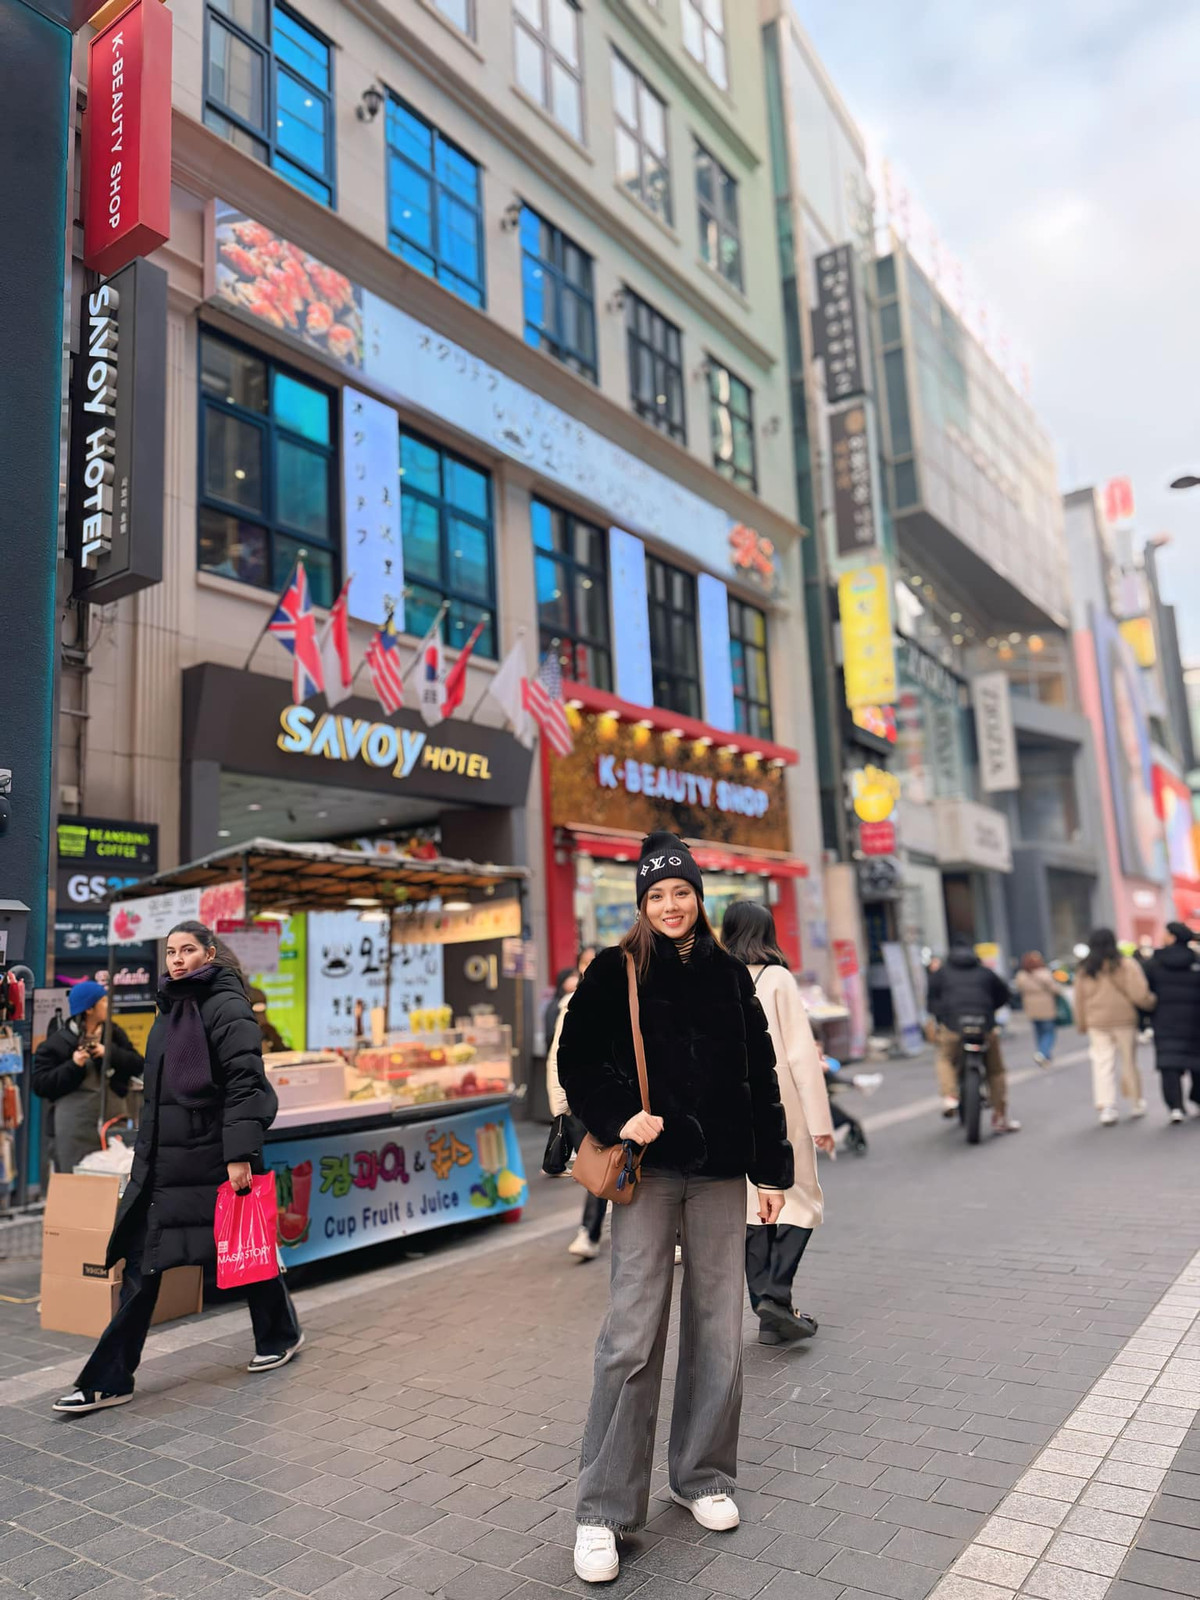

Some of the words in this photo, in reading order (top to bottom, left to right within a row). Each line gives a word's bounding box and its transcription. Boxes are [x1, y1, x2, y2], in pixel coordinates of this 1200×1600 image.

[110, 31, 124, 153] K-BEAUTY
[108, 161, 122, 229] SHOP
[81, 426, 115, 570] HOTEL
[276, 704, 427, 779] SAVOY
[422, 744, 492, 780] HOTEL
[715, 779, 769, 819] SHOP
[324, 1215, 357, 1239] Cup
[362, 1202, 400, 1230] Fruit
[405, 1202, 414, 1220] &
[421, 1190, 459, 1216] Juice
